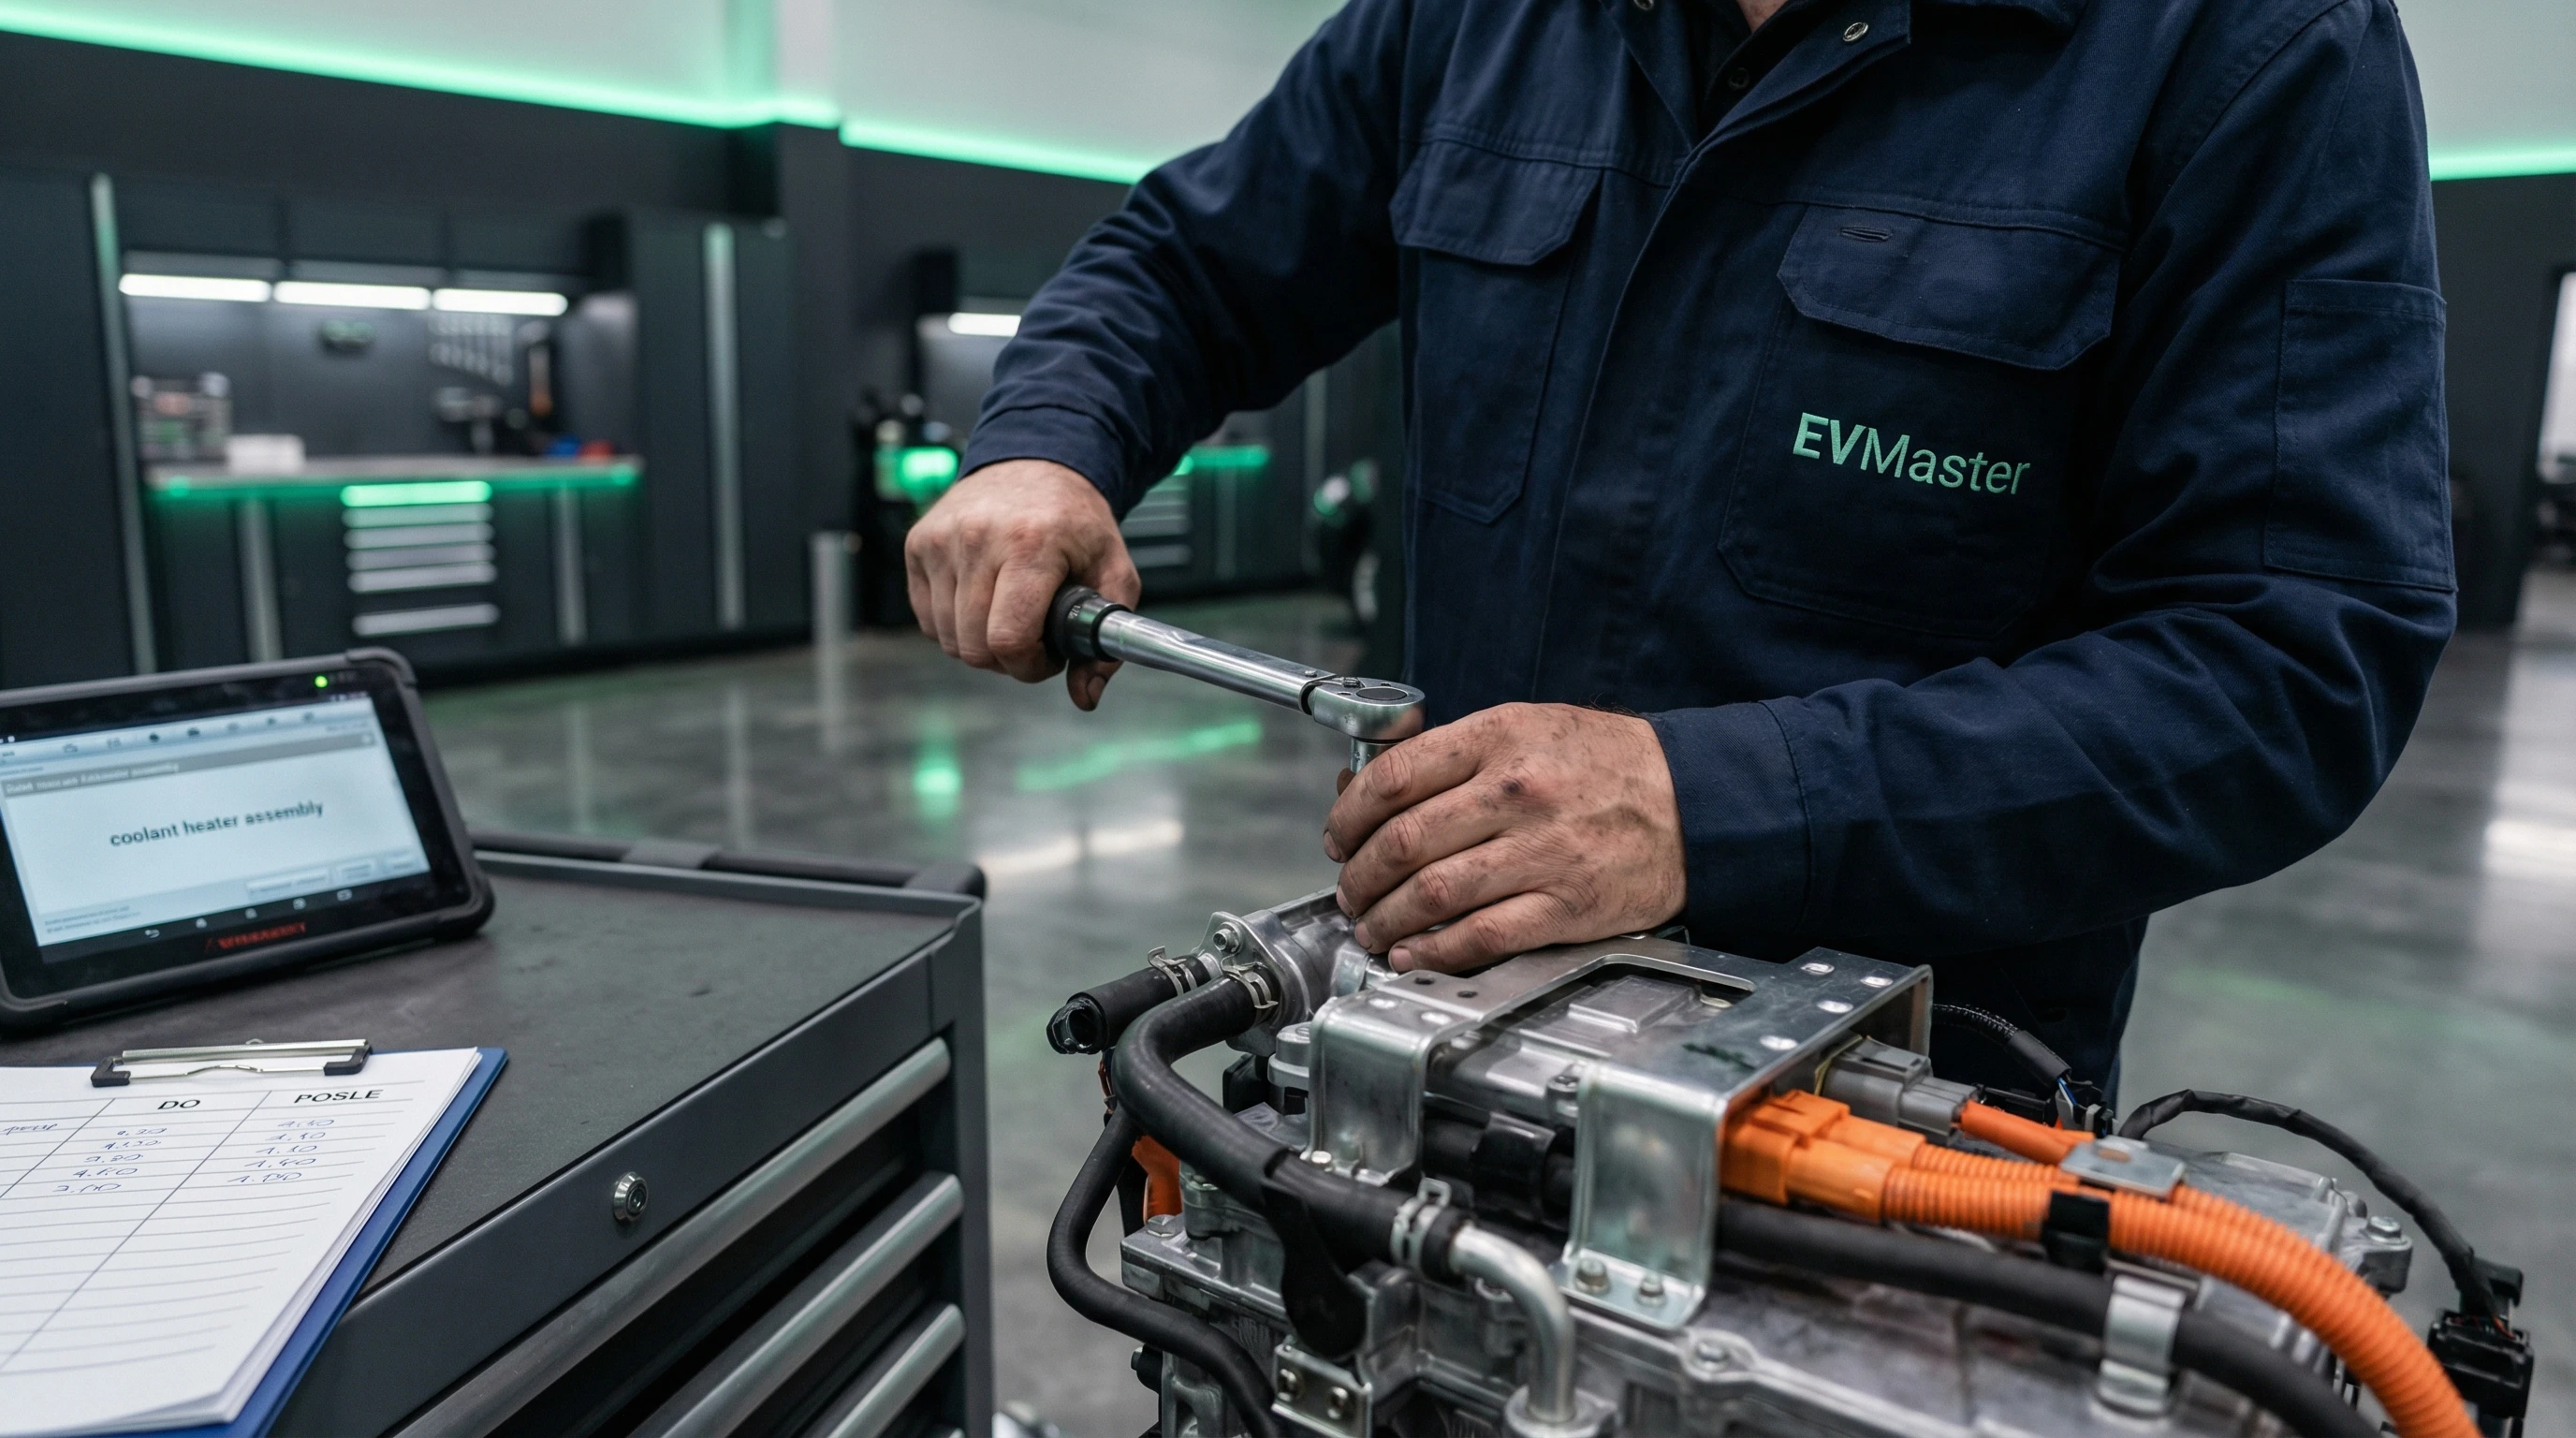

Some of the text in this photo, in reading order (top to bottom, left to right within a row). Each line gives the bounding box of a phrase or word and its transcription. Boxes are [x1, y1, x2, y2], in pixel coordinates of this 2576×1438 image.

[1793, 412, 2030, 494] EVMaster
[110, 800, 323, 846] coolant heater assembly
[157, 1099, 200, 1110] DO
[294, 1090, 384, 1104] POSLE
